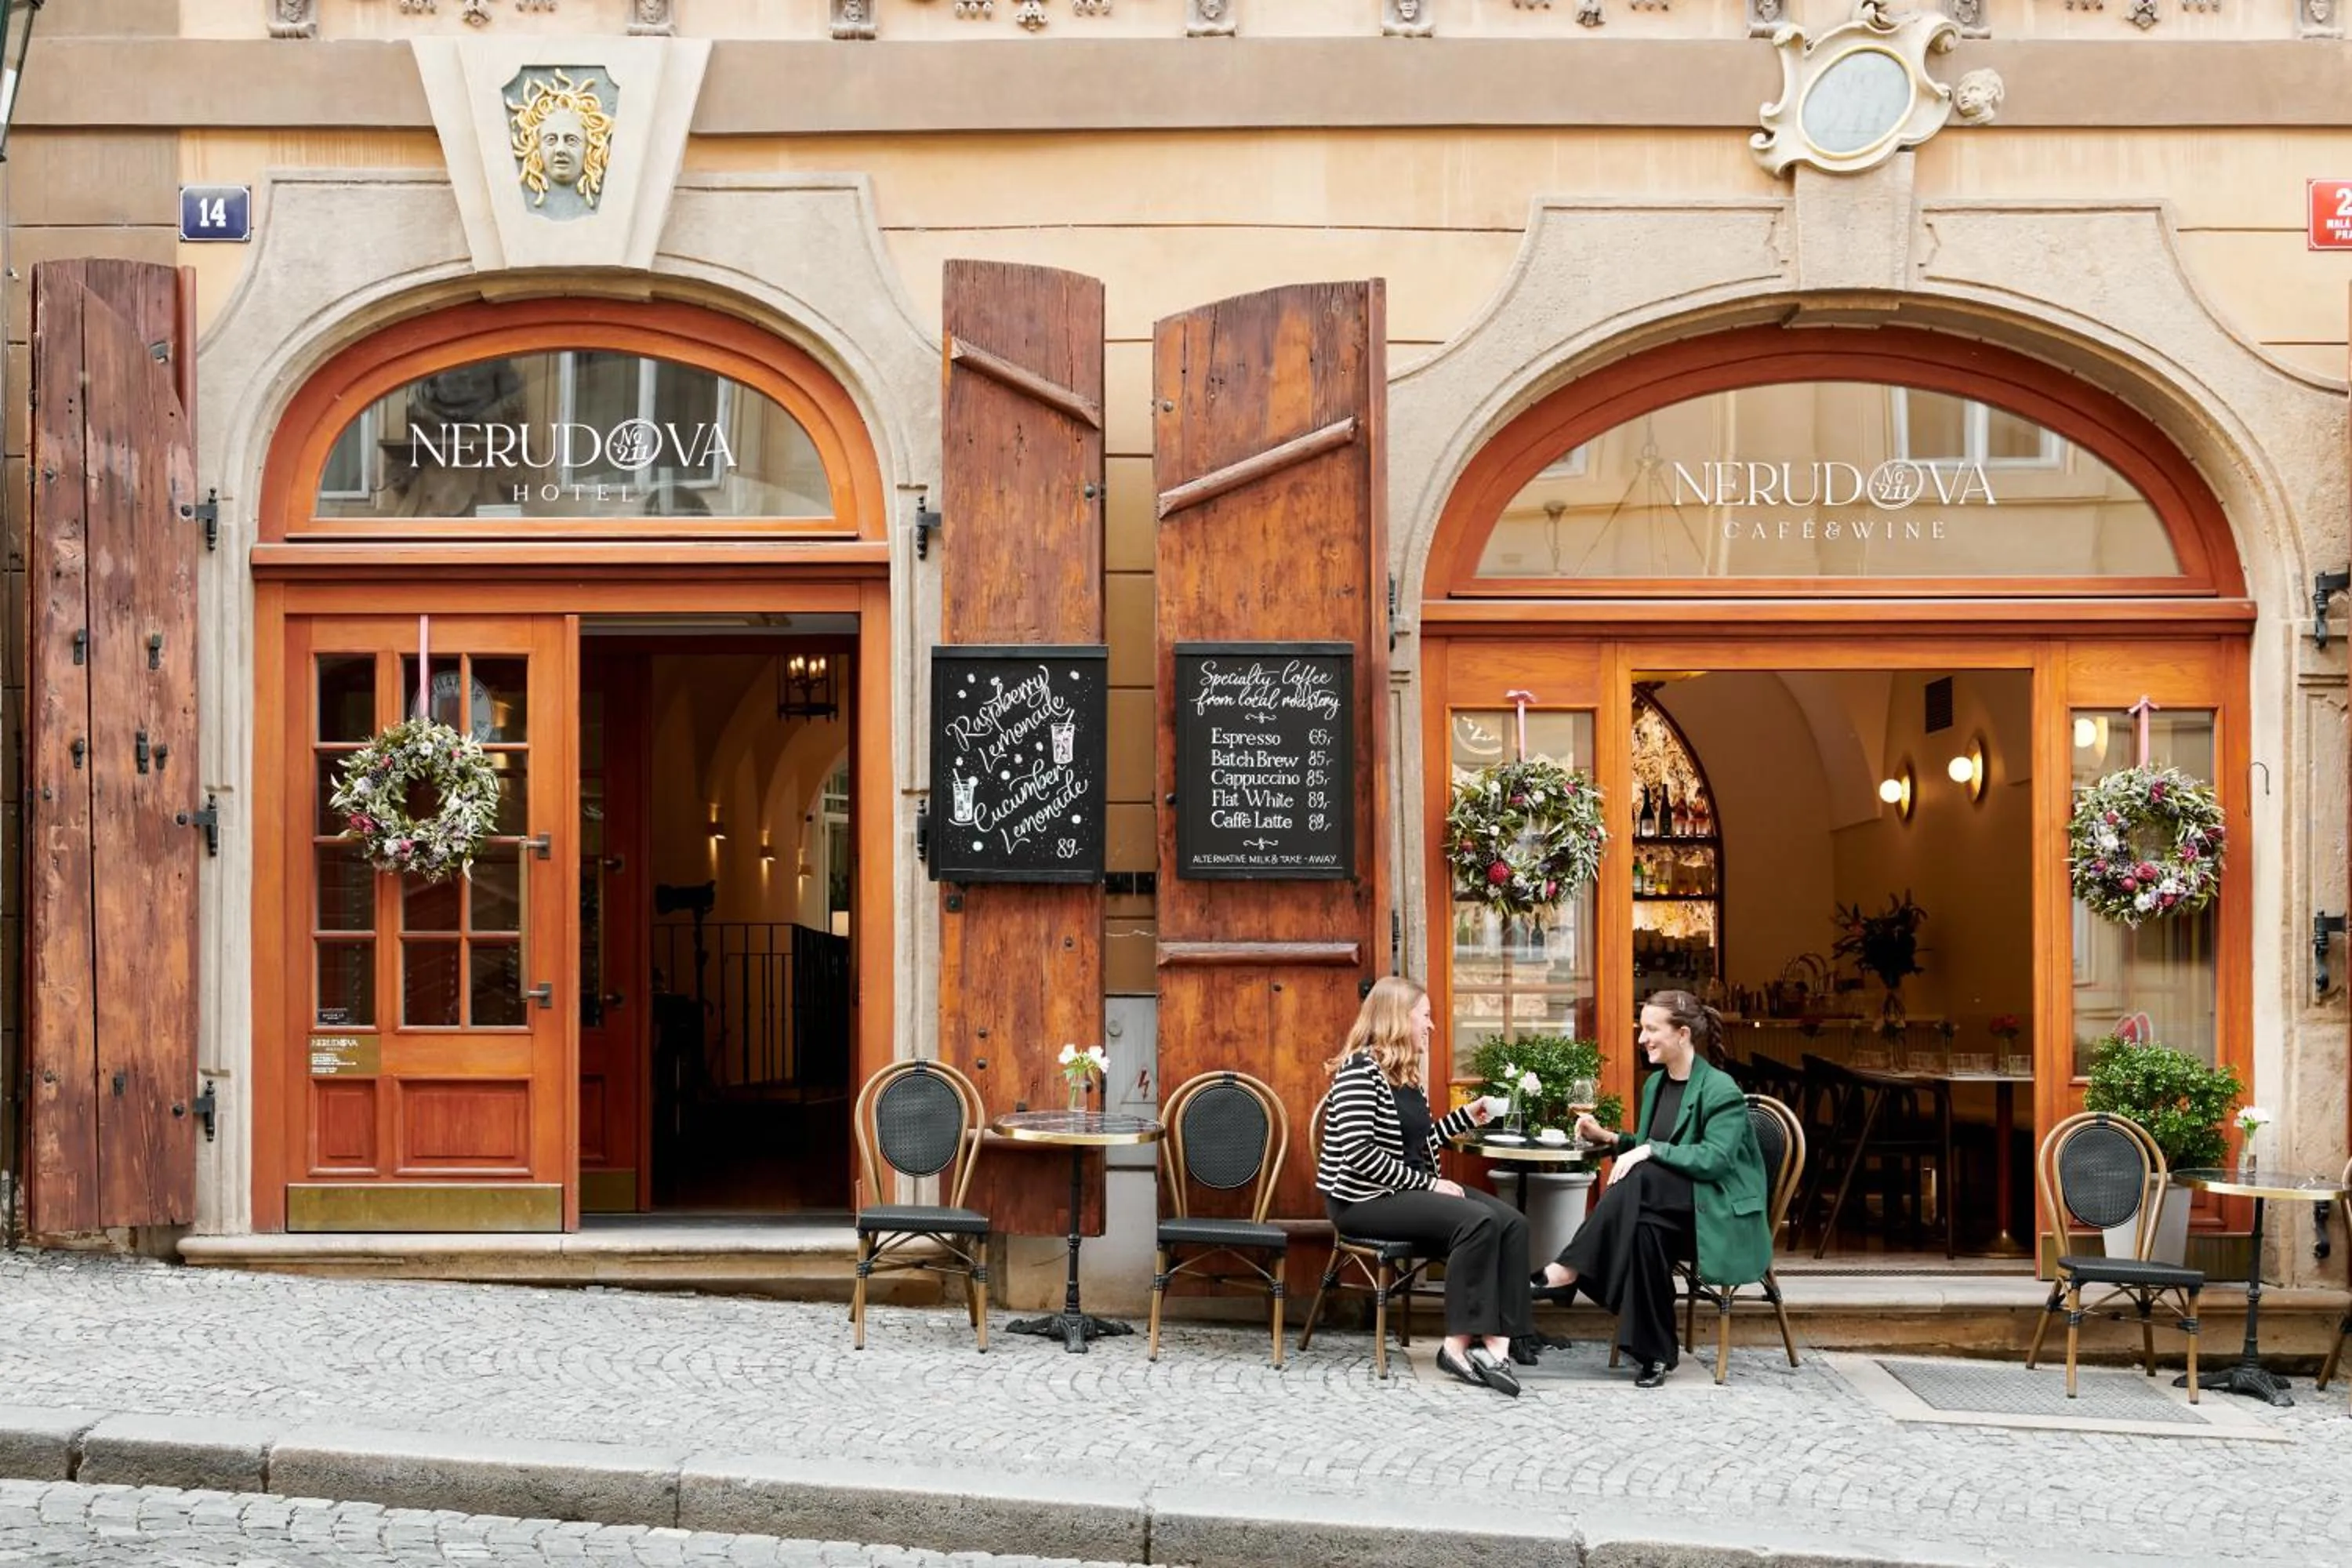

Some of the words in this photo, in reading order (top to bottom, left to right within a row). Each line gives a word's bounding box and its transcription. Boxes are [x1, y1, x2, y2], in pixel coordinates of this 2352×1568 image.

[199, 198, 226, 227] 14
[409, 418, 738, 470] NERUDOVA
[514, 484, 633, 503] HOTEL
[1673, 459, 1998, 510] NERUDOVA
[1199, 660, 1280, 700] Specialty
[1281, 659, 1333, 699] Coffee
[946, 665, 1050, 752] Raspberry
[1189, 688, 1236, 716] from
[1238, 688, 1281, 710] local
[978, 686, 1071, 774] Lemonade
[1210, 728, 1281, 749] Espresso
[1210, 750, 1254, 768] Batch
[1256, 750, 1299, 768] Brew
[1210, 769, 1301, 790] Cappuccino
[949, 758, 1066, 833] Cucumber
[1211, 789, 1240, 808] Flat
[1244, 789, 1294, 808] White
[1000, 769, 1088, 855] Lemonade
[1254, 811, 1293, 829] Latte
[1192, 854, 1247, 863] ALTERNATIVE
